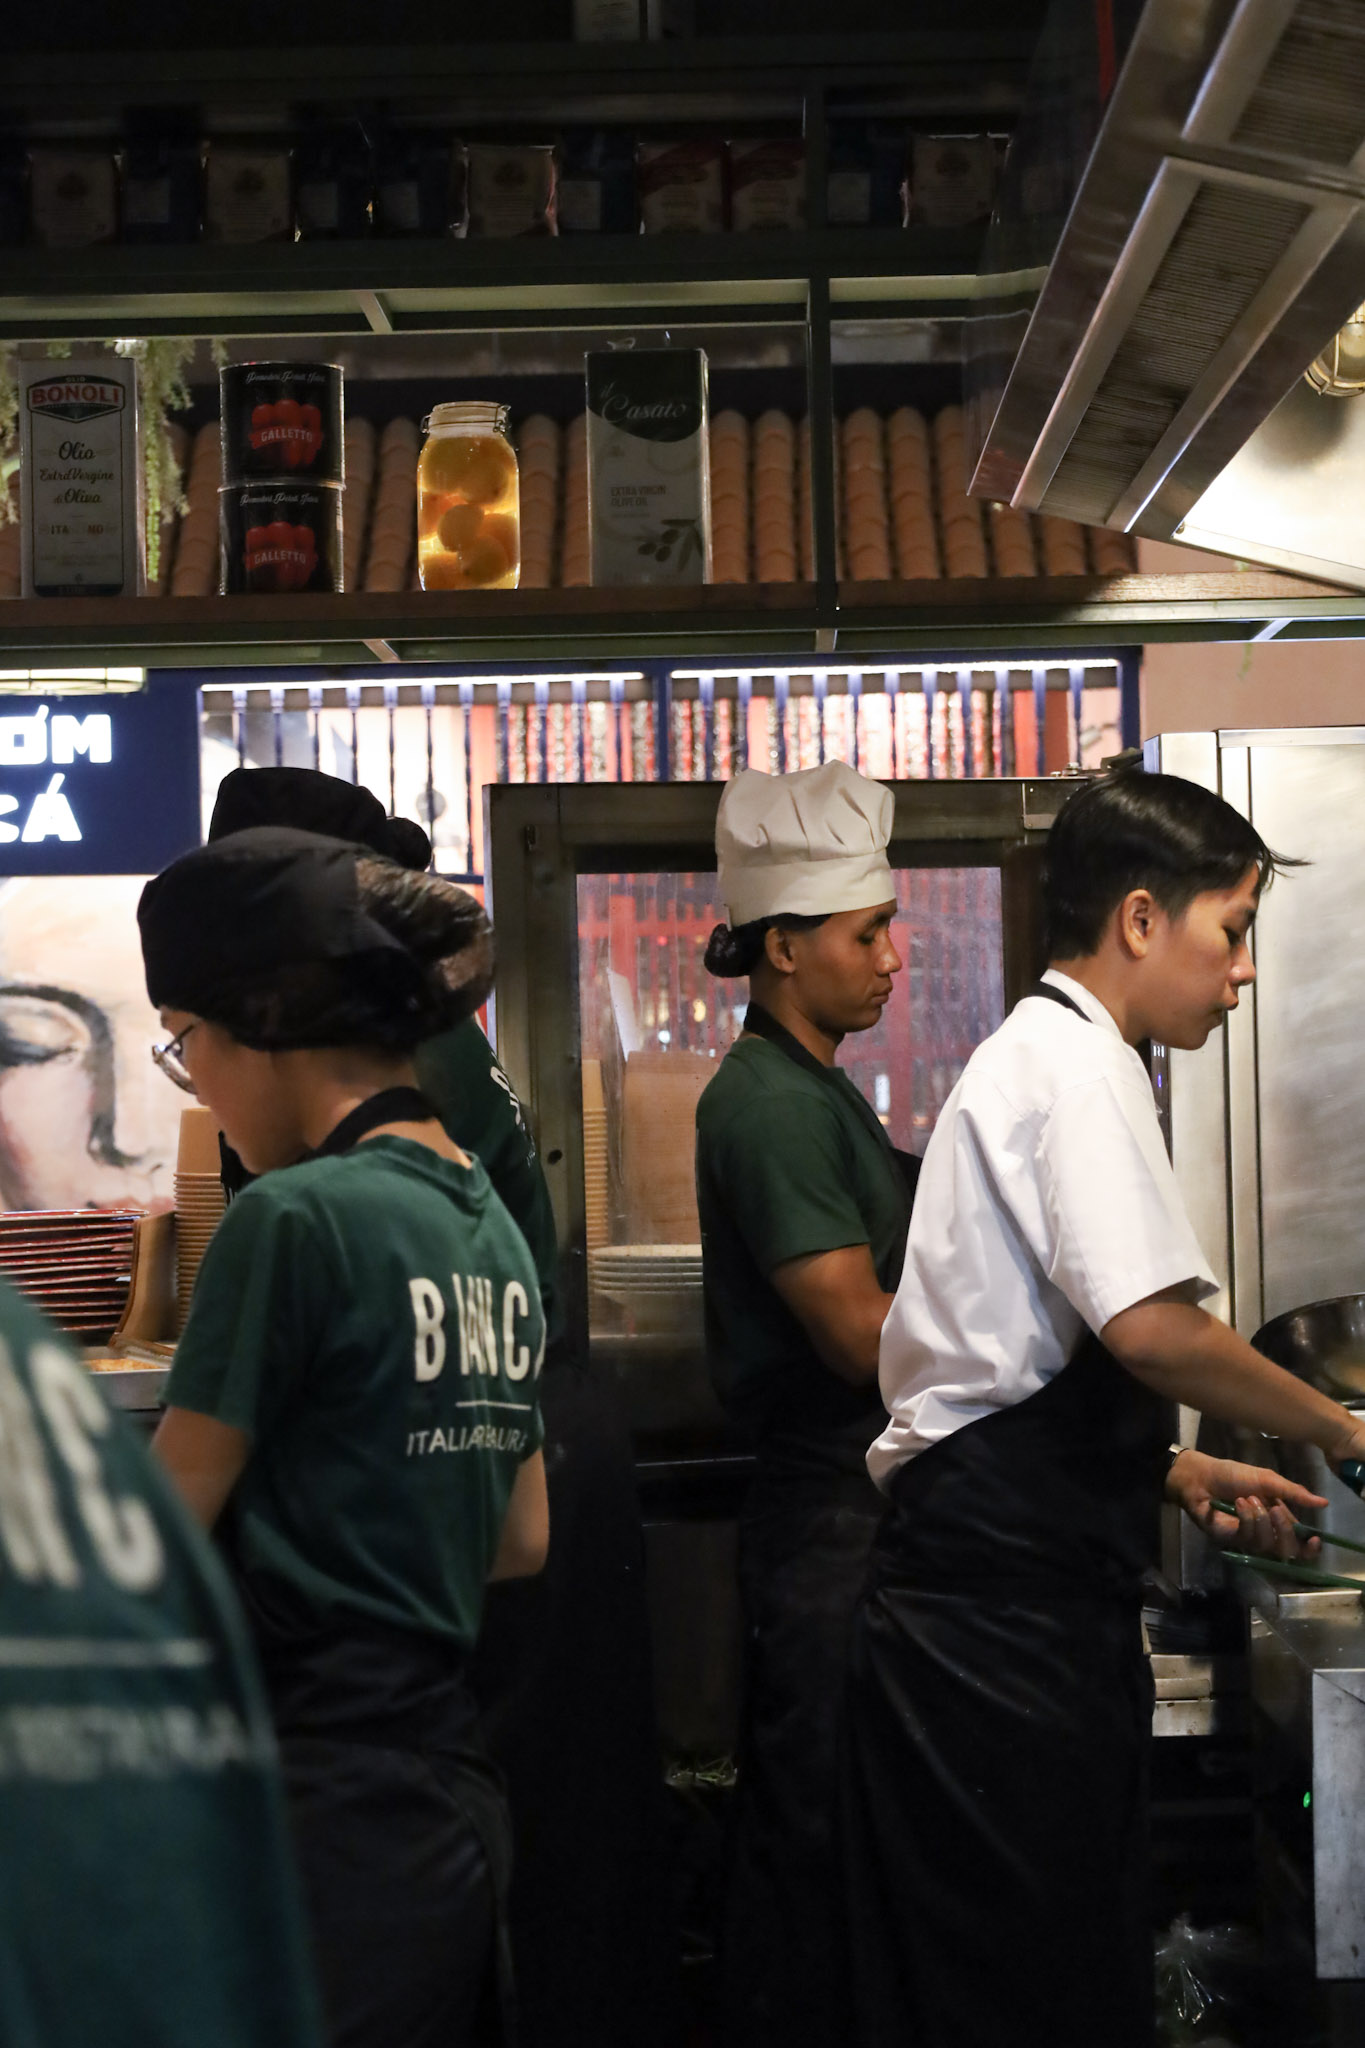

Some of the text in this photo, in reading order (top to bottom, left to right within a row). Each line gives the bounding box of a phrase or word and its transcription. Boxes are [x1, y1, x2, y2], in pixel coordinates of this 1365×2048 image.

[31, 385, 119, 404] BONOLI
[601, 393, 688, 423] Casato
[261, 428, 313, 443] GALLETTO
[58, 440, 96, 460] Olio
[64, 488, 102, 504] Oliva
[255, 550, 306, 565] GALLETTO
